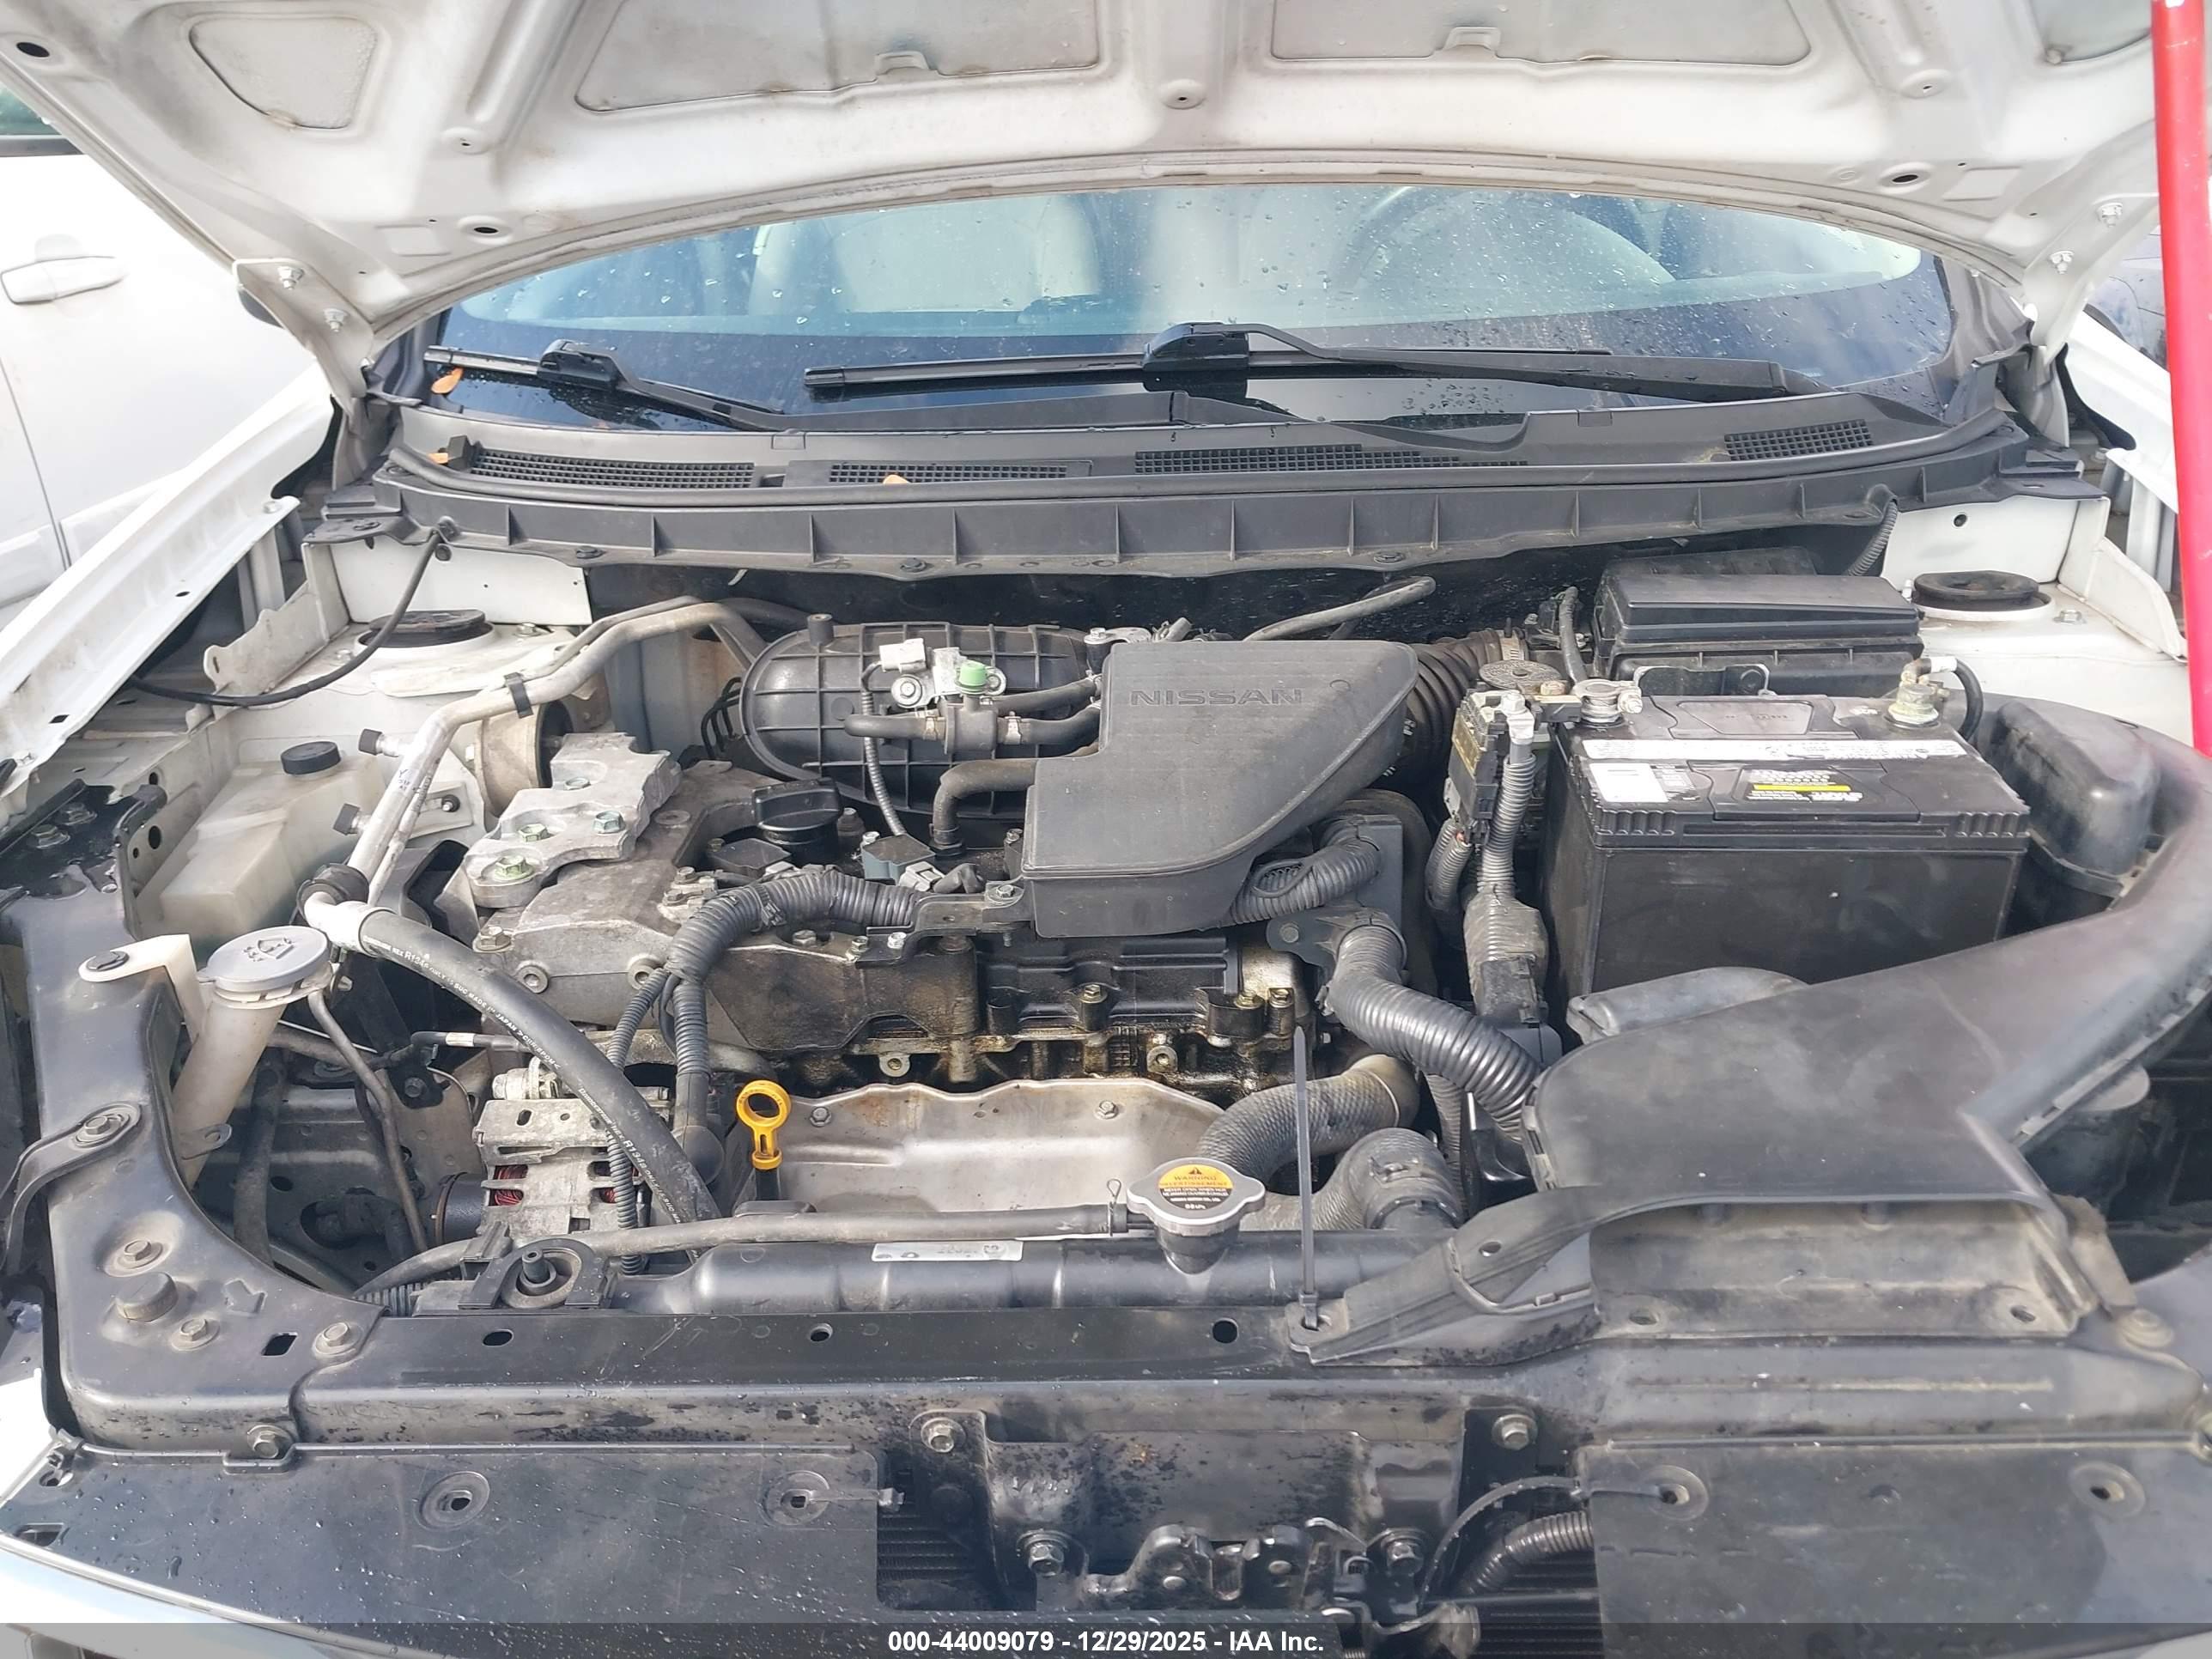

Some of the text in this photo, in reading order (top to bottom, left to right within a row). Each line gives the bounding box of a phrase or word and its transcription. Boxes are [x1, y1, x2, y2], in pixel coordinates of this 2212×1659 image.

[1130, 689, 1302, 705] NISSAN
[468, 992, 486, 1008] MADE
[495, 1013, 517, 1031] JAPAN
